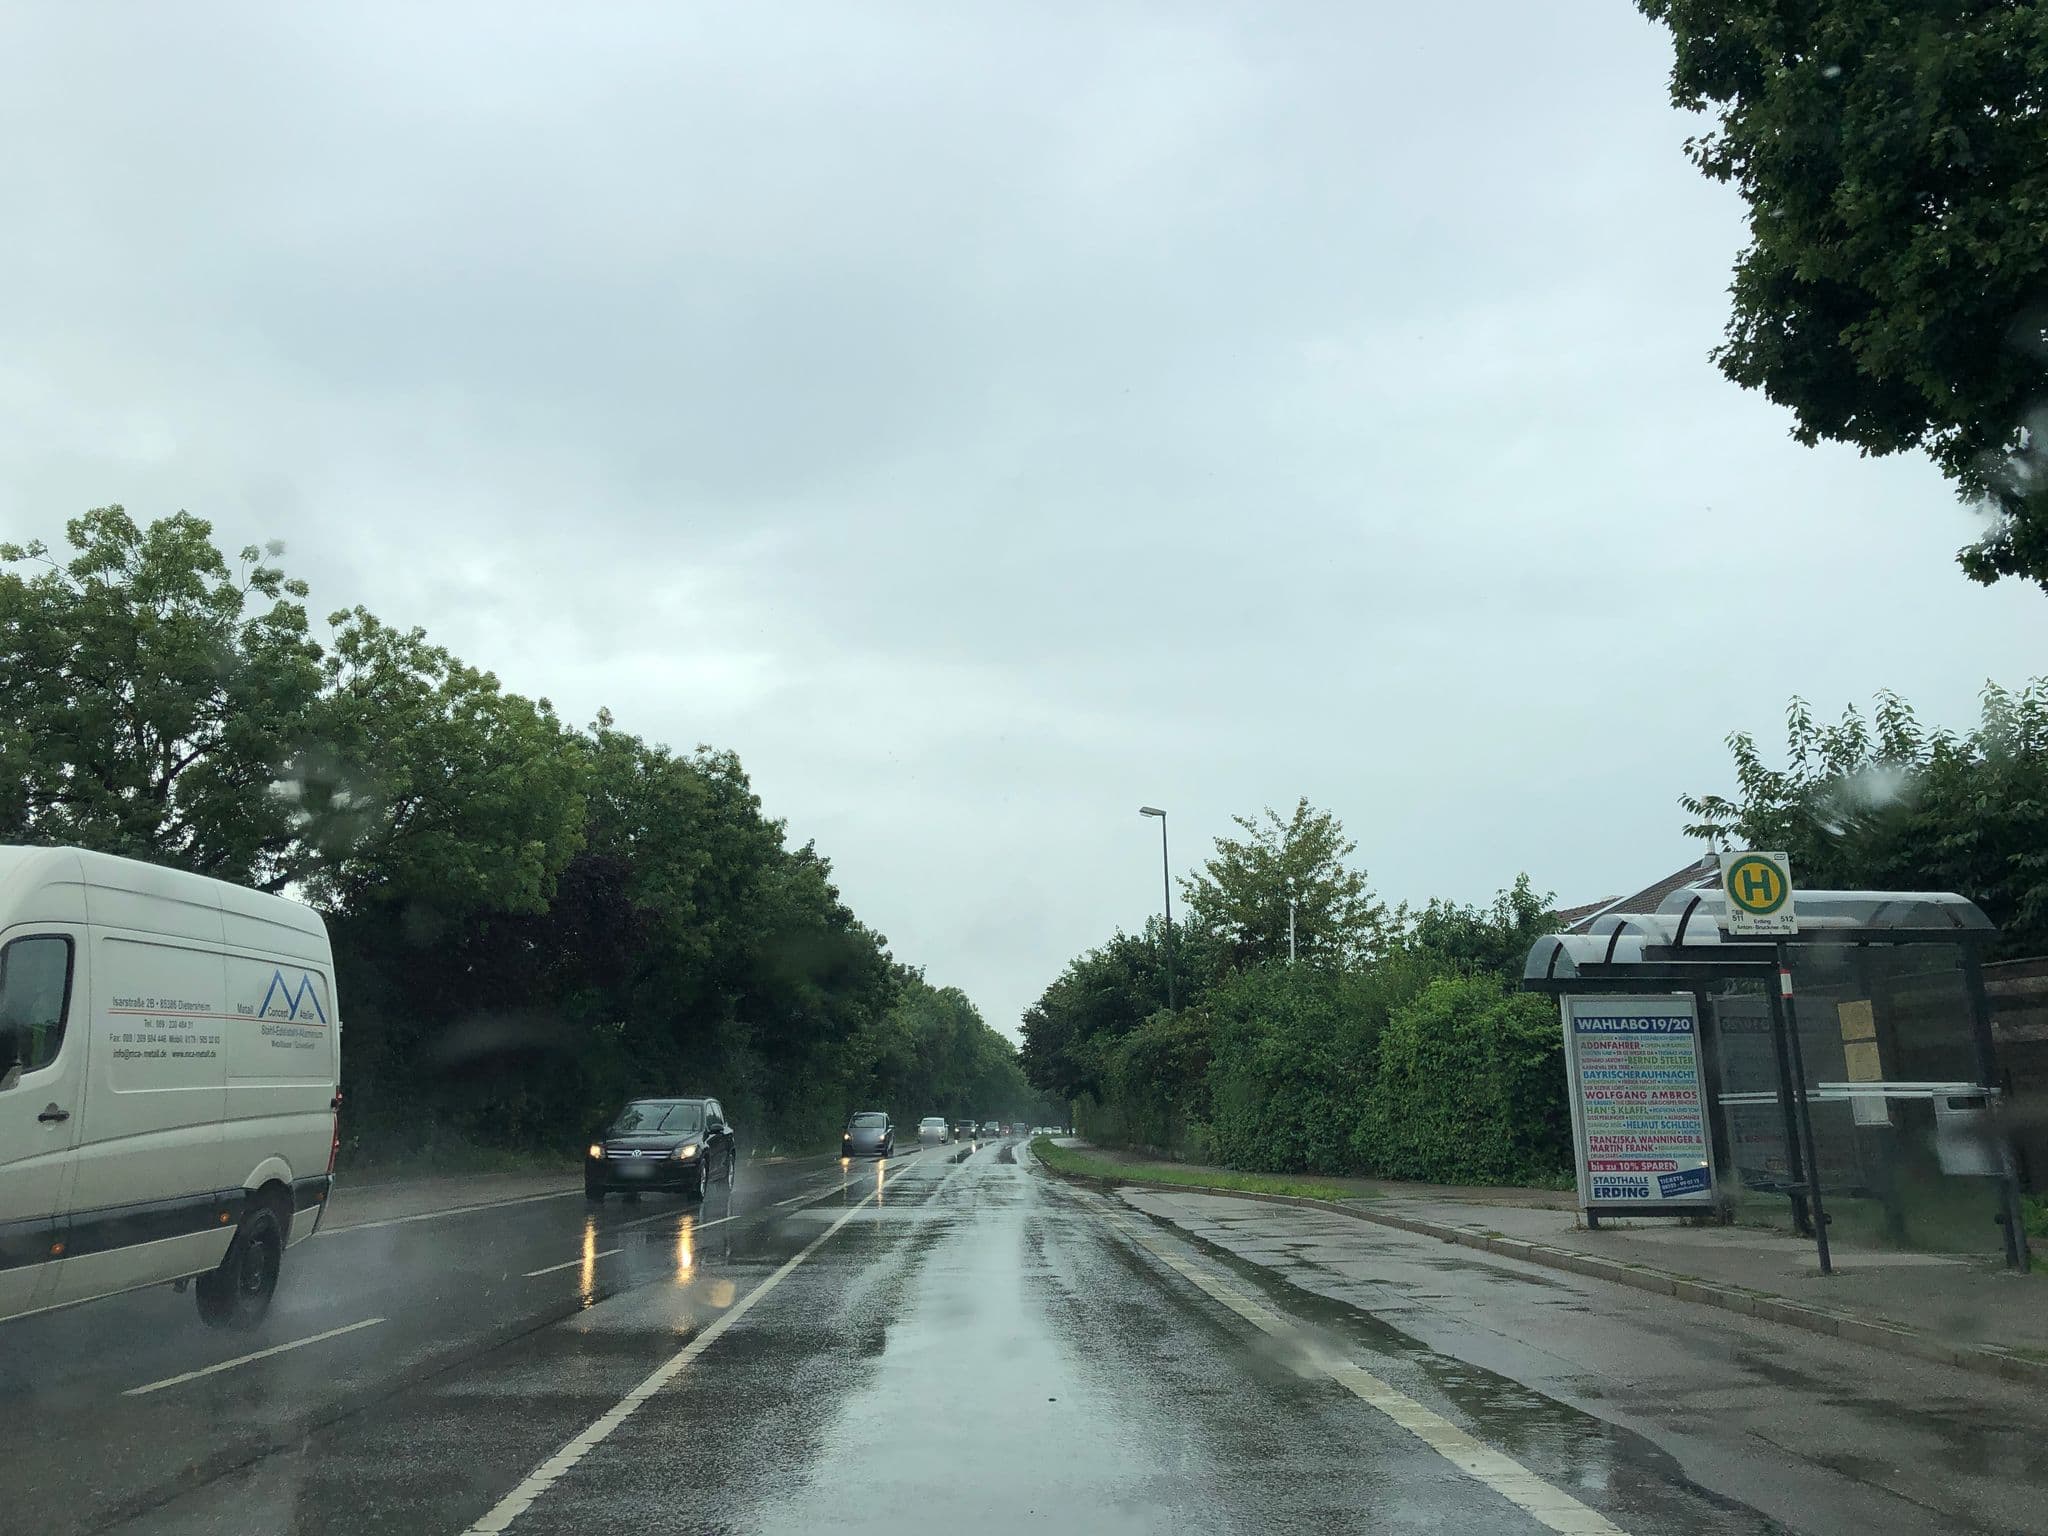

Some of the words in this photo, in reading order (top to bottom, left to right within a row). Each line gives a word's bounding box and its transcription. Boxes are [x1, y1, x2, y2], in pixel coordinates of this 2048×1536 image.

[1742, 869, 1772, 901] H
[1732, 914, 1744, 922] 511
[1780, 914, 1794, 923] 512
[112, 996, 145, 1008] Isarstraße
[146, 998, 155, 1008] 2B
[267, 1006, 289, 1020] Concept
[1578, 1018, 1650, 1030] WAHLABO
[1652, 1018, 1691, 1032] 19/20
[1627, 1056, 1659, 1064] BERND
[1660, 1056, 1693, 1064] STELTER
[1585, 1091, 1648, 1100] WOLFGANG
[1651, 1091, 1698, 1100] AMBROS
[1586, 1106, 1616, 1115] HAN'S
[1626, 1120, 1659, 1129] HELMUT
[1660, 1120, 1701, 1129] SCHLEICH
[1589, 1135, 1636, 1144] FRANZISKA
[1638, 1135, 1692, 1144] WANNINGER
[1590, 1144, 1623, 1152] MARTIN
[1625, 1144, 1654, 1152] FRANK
[1590, 1161, 1604, 1171] bis
[1641, 1161, 1677, 1171] SPAREN
[1593, 1176, 1649, 1185] STADTHALLE
[1593, 1187, 1650, 1198] ERDING
